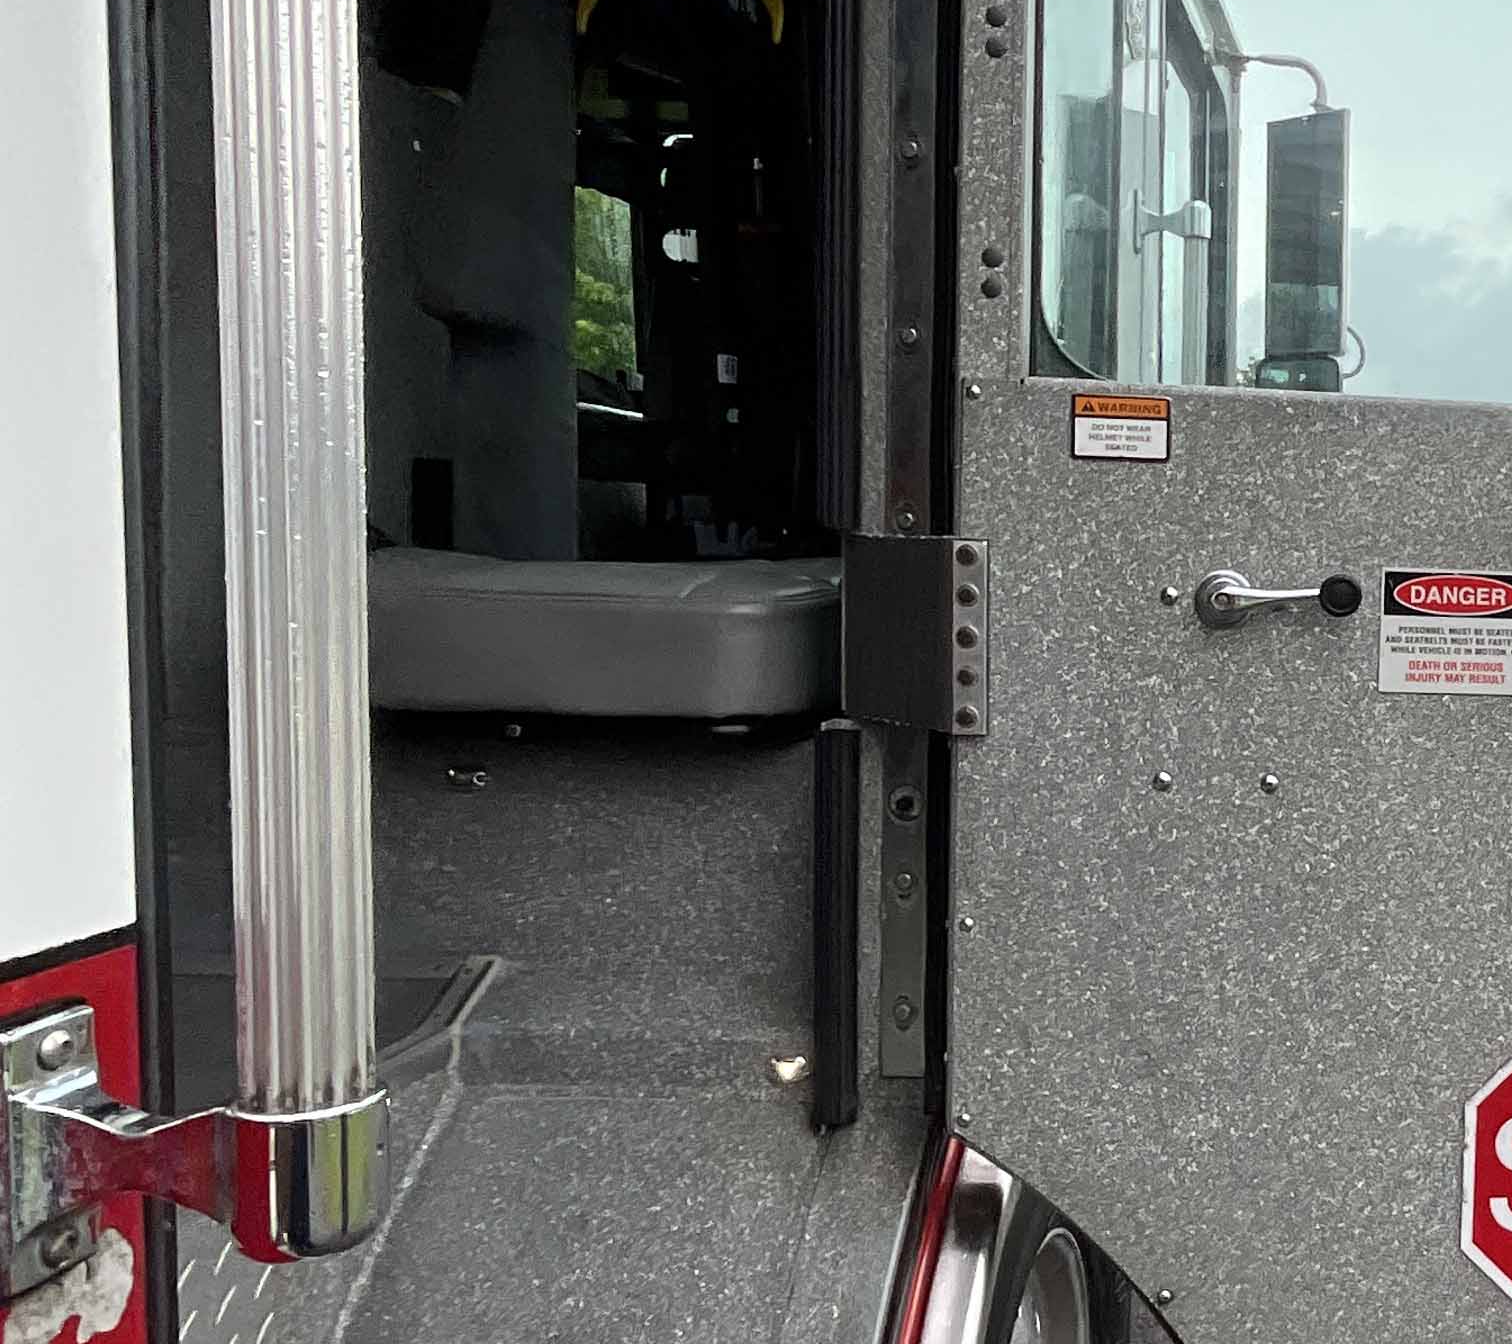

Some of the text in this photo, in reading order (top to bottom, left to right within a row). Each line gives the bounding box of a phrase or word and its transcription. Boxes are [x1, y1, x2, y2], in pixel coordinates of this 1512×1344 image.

[1097, 402, 1161, 415] WARNING
[1410, 585, 1507, 606] DANGER
[1398, 626, 1445, 635] PERSONNEL
[1449, 627, 1471, 635] MUST
[1474, 628, 1483, 636] BE
[1385, 635, 1402, 643] AND
[1450, 637, 1473, 646] MUST
[1475, 638, 1485, 646] BE
[1391, 646, 1415, 654] WHILE
[1418, 646, 1451, 655] VEHICLE
[1454, 647, 1461, 655] IS
[1464, 647, 1472, 655] IN
[1408, 660, 1504, 672] DEATH OR SERIOUS
[1405, 673, 1506, 684] INJURY MAY RESULT
